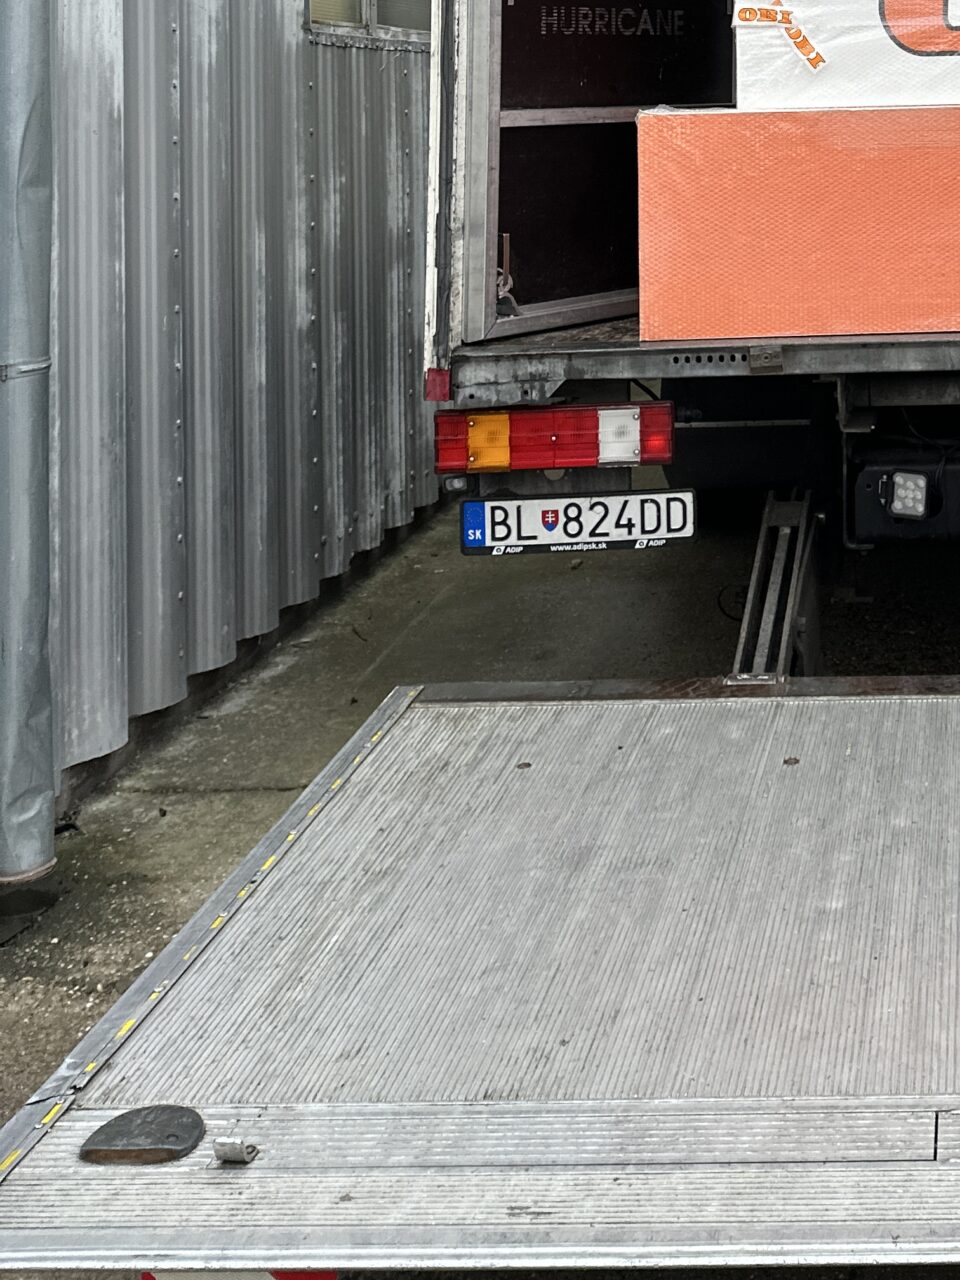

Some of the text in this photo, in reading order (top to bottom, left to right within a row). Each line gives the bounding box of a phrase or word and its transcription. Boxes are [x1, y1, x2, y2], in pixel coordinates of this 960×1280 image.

[540, 6, 684, 36] HURRICANE
[738, 7, 793, 24] OBI
[467, 496, 688, 542] SK BL 824DD
[550, 542, 607, 552] www.adipsk.sk
